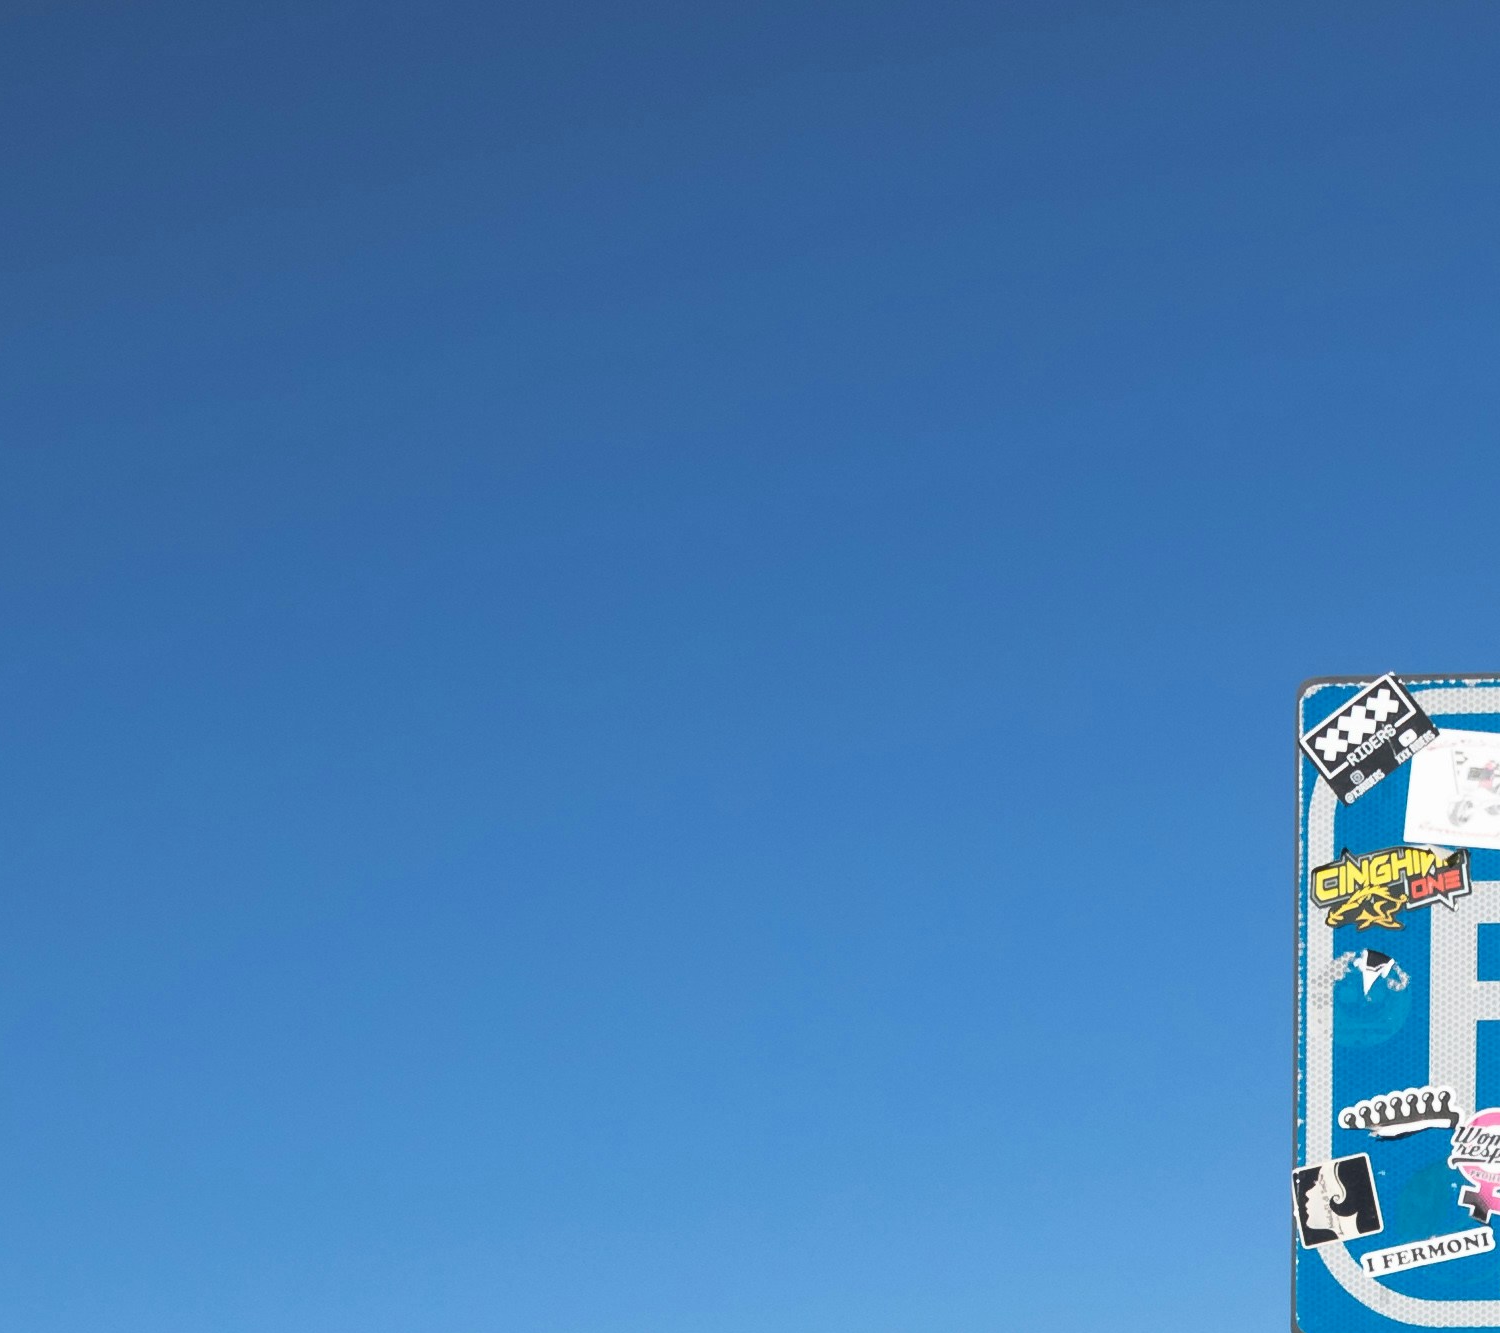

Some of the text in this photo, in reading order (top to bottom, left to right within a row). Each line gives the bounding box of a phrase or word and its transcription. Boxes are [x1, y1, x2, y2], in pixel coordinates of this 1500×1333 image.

[1347, 723, 1397, 766] RIDERS
[1411, 869, 1461, 898] ONE
[1366, 1232, 1490, 1272] I FERMONI
